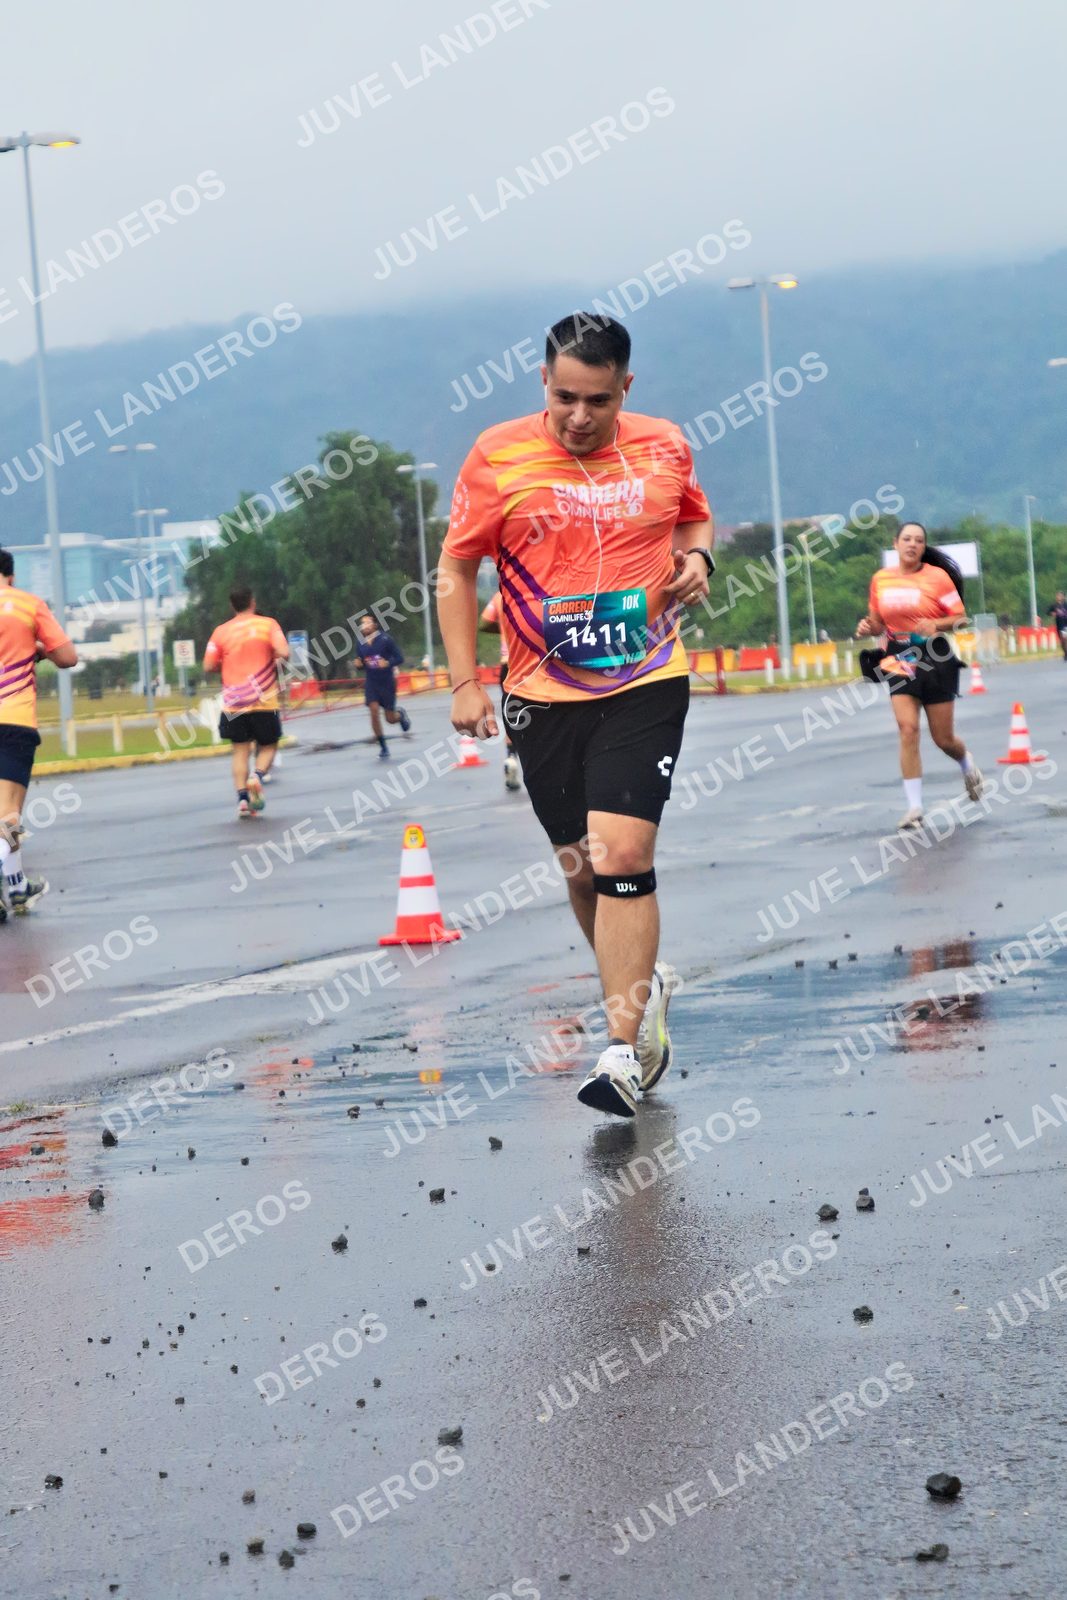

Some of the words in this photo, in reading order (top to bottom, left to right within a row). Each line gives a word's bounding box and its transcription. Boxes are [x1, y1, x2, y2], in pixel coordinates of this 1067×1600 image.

[552, 478, 645, 505] CARRERA
[548, 600, 594, 616] CARRERA
[622, 594, 640, 610] 10K
[549, 612, 584, 624] OMNILIFE
[566, 622, 627, 648] 1411
